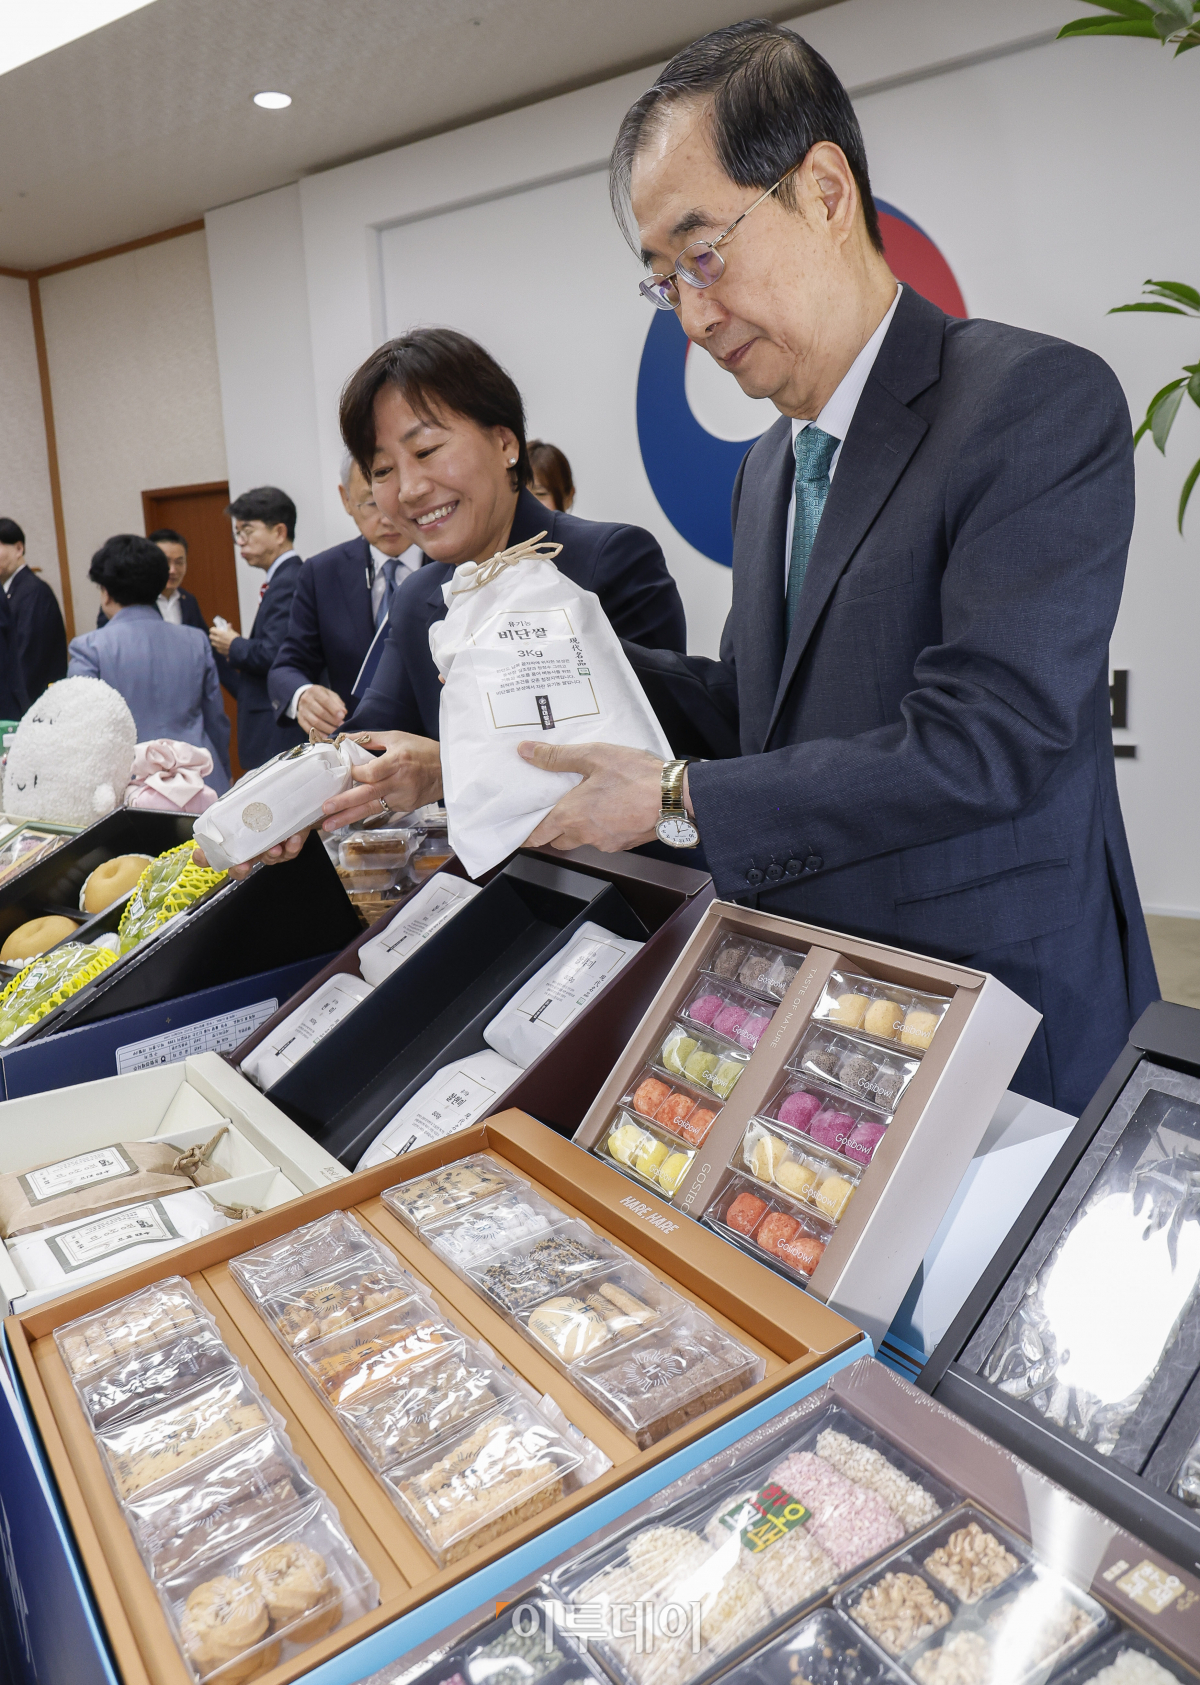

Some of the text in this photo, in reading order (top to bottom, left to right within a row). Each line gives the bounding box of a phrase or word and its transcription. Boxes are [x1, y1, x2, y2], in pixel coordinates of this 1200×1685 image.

[497, 627, 548, 641] 비단쌀
[517, 649, 543, 658] 3Kg
[769, 967, 818, 1049] TASTE OF NATURE
[892, 1020, 932, 1039] Gosibowl
[857, 1077, 894, 1098] Gosibowl
[835, 1133, 873, 1155] Gosibowl
[801, 1183, 837, 1208] Gosibowl
[777, 1238, 814, 1264] Gosibowl
